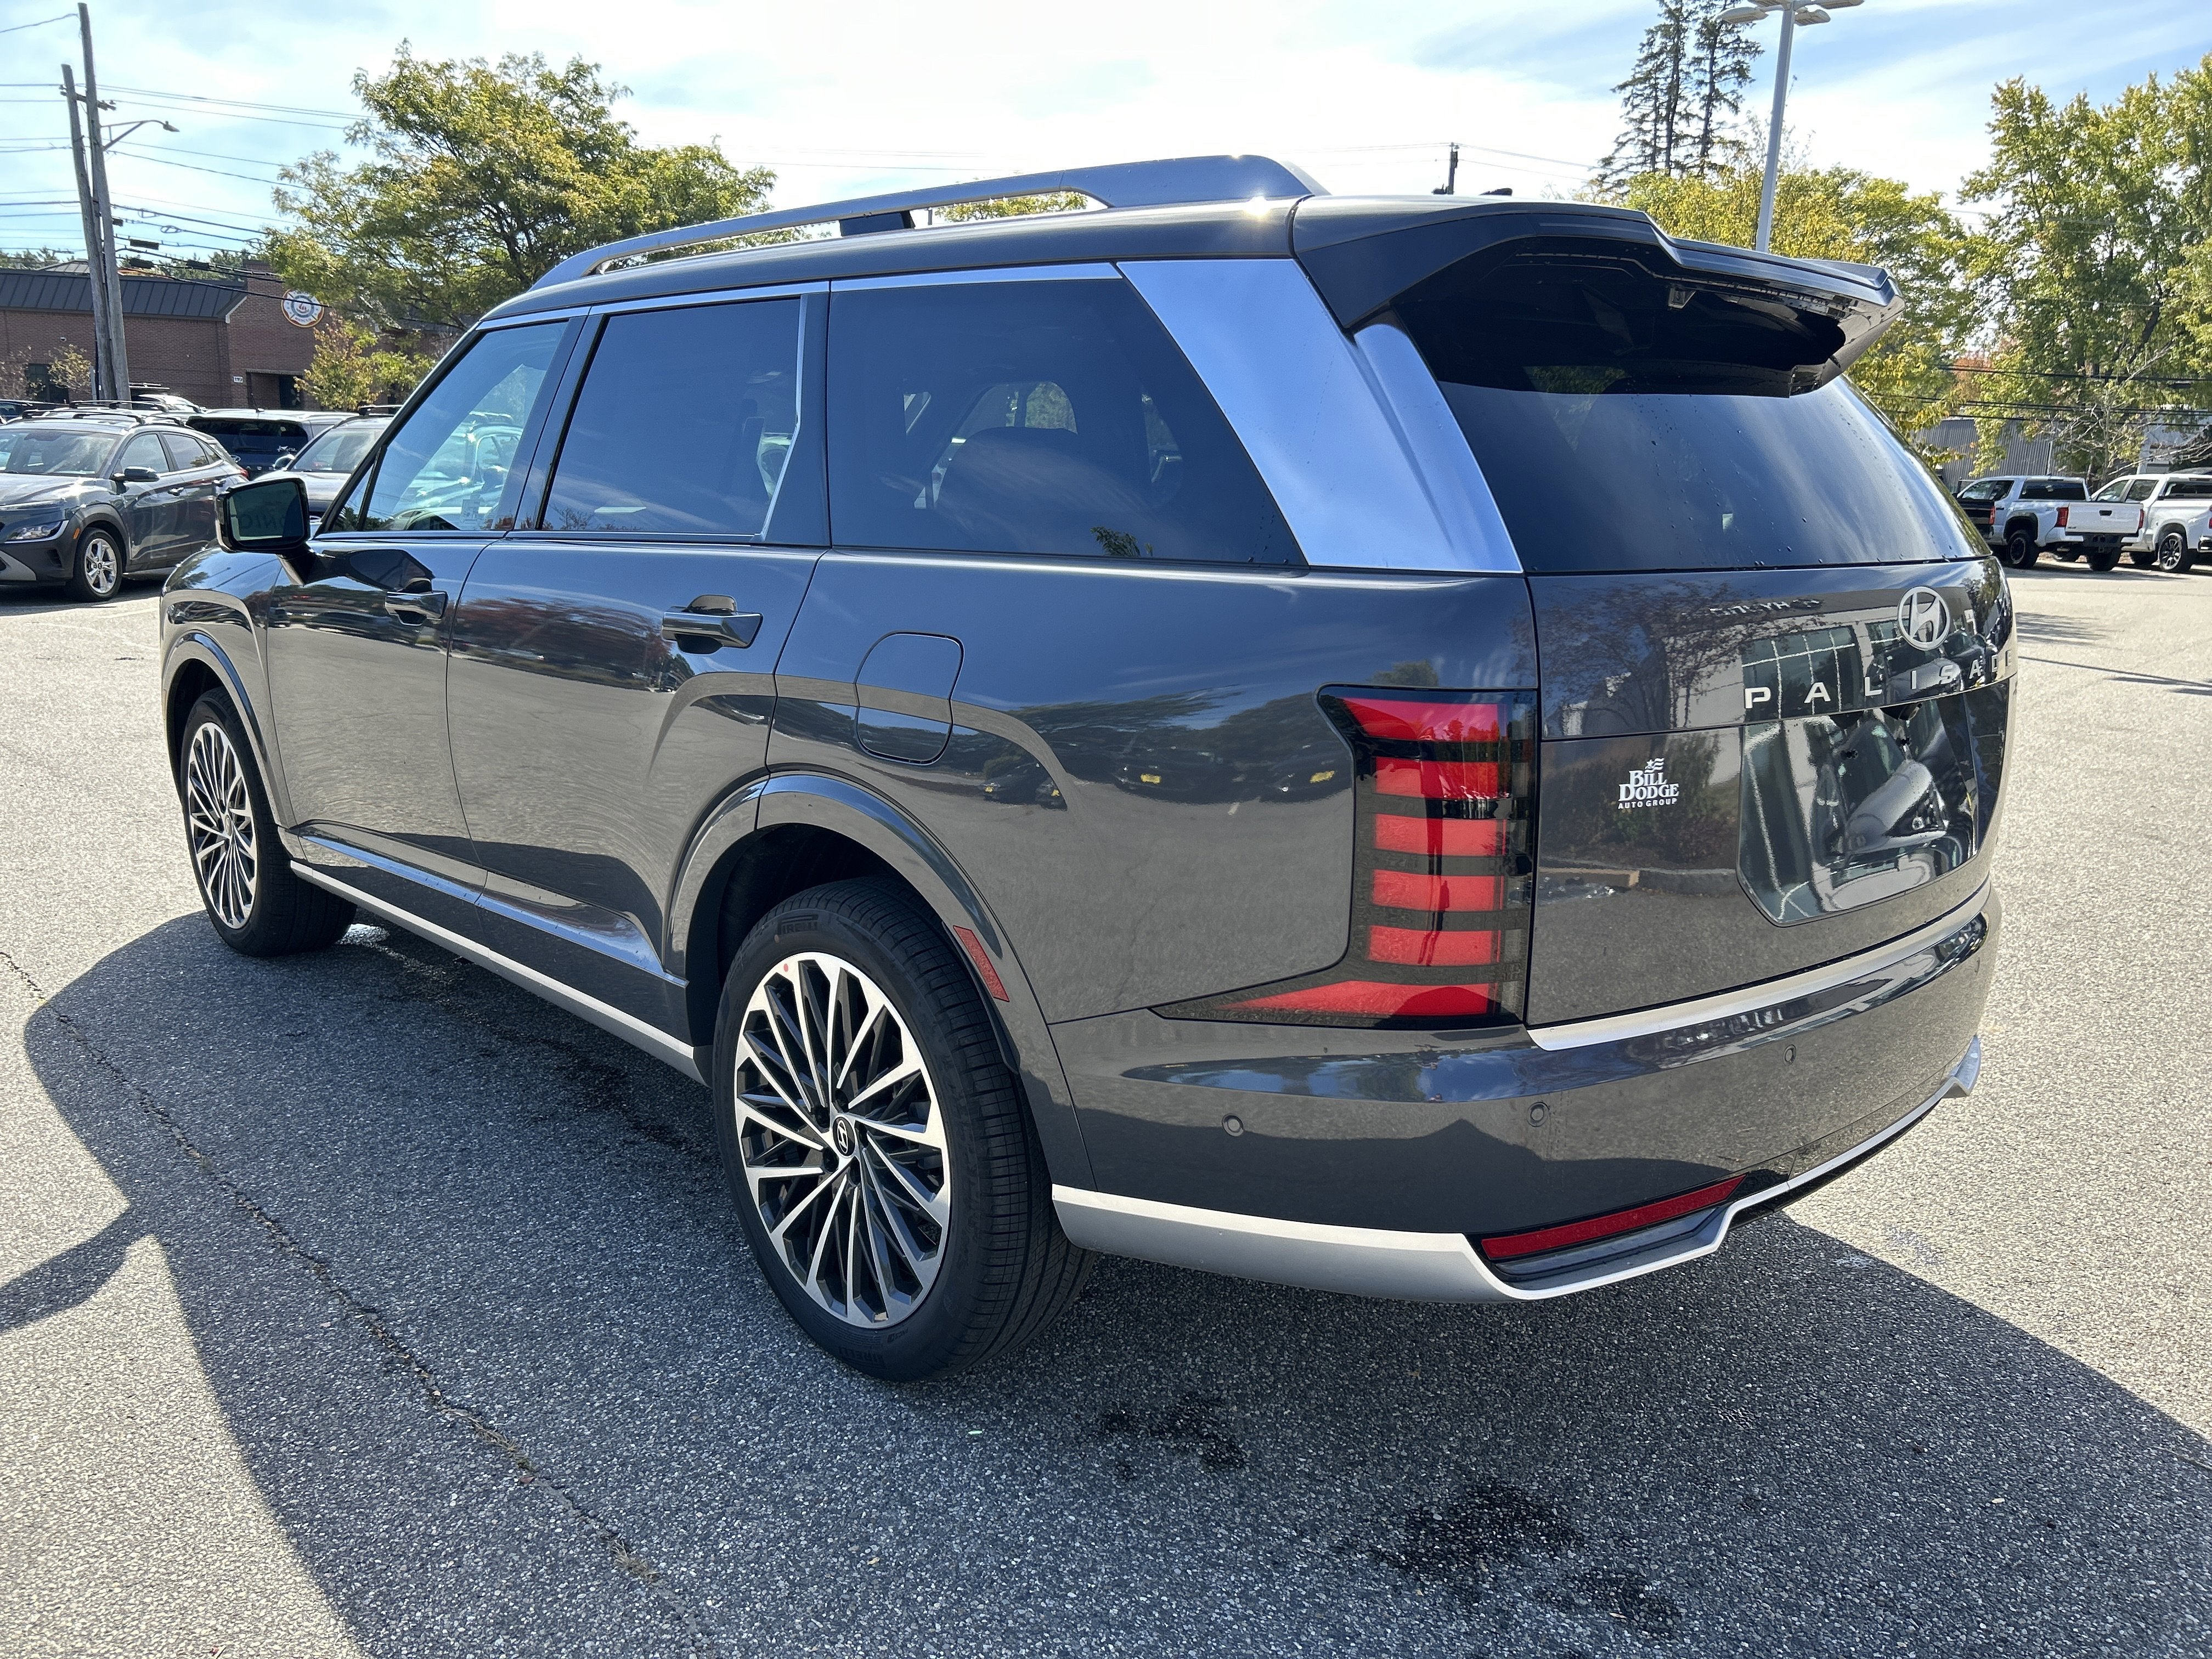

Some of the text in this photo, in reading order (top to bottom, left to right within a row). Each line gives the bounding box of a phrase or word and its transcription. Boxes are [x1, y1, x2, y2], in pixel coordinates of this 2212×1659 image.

[1745, 649, 2012, 708] PALISADE
[1629, 770, 1667, 787] BILL
[1618, 783, 1679, 801] DODGE
[1618, 798, 1677, 809] AUTO GROUP
